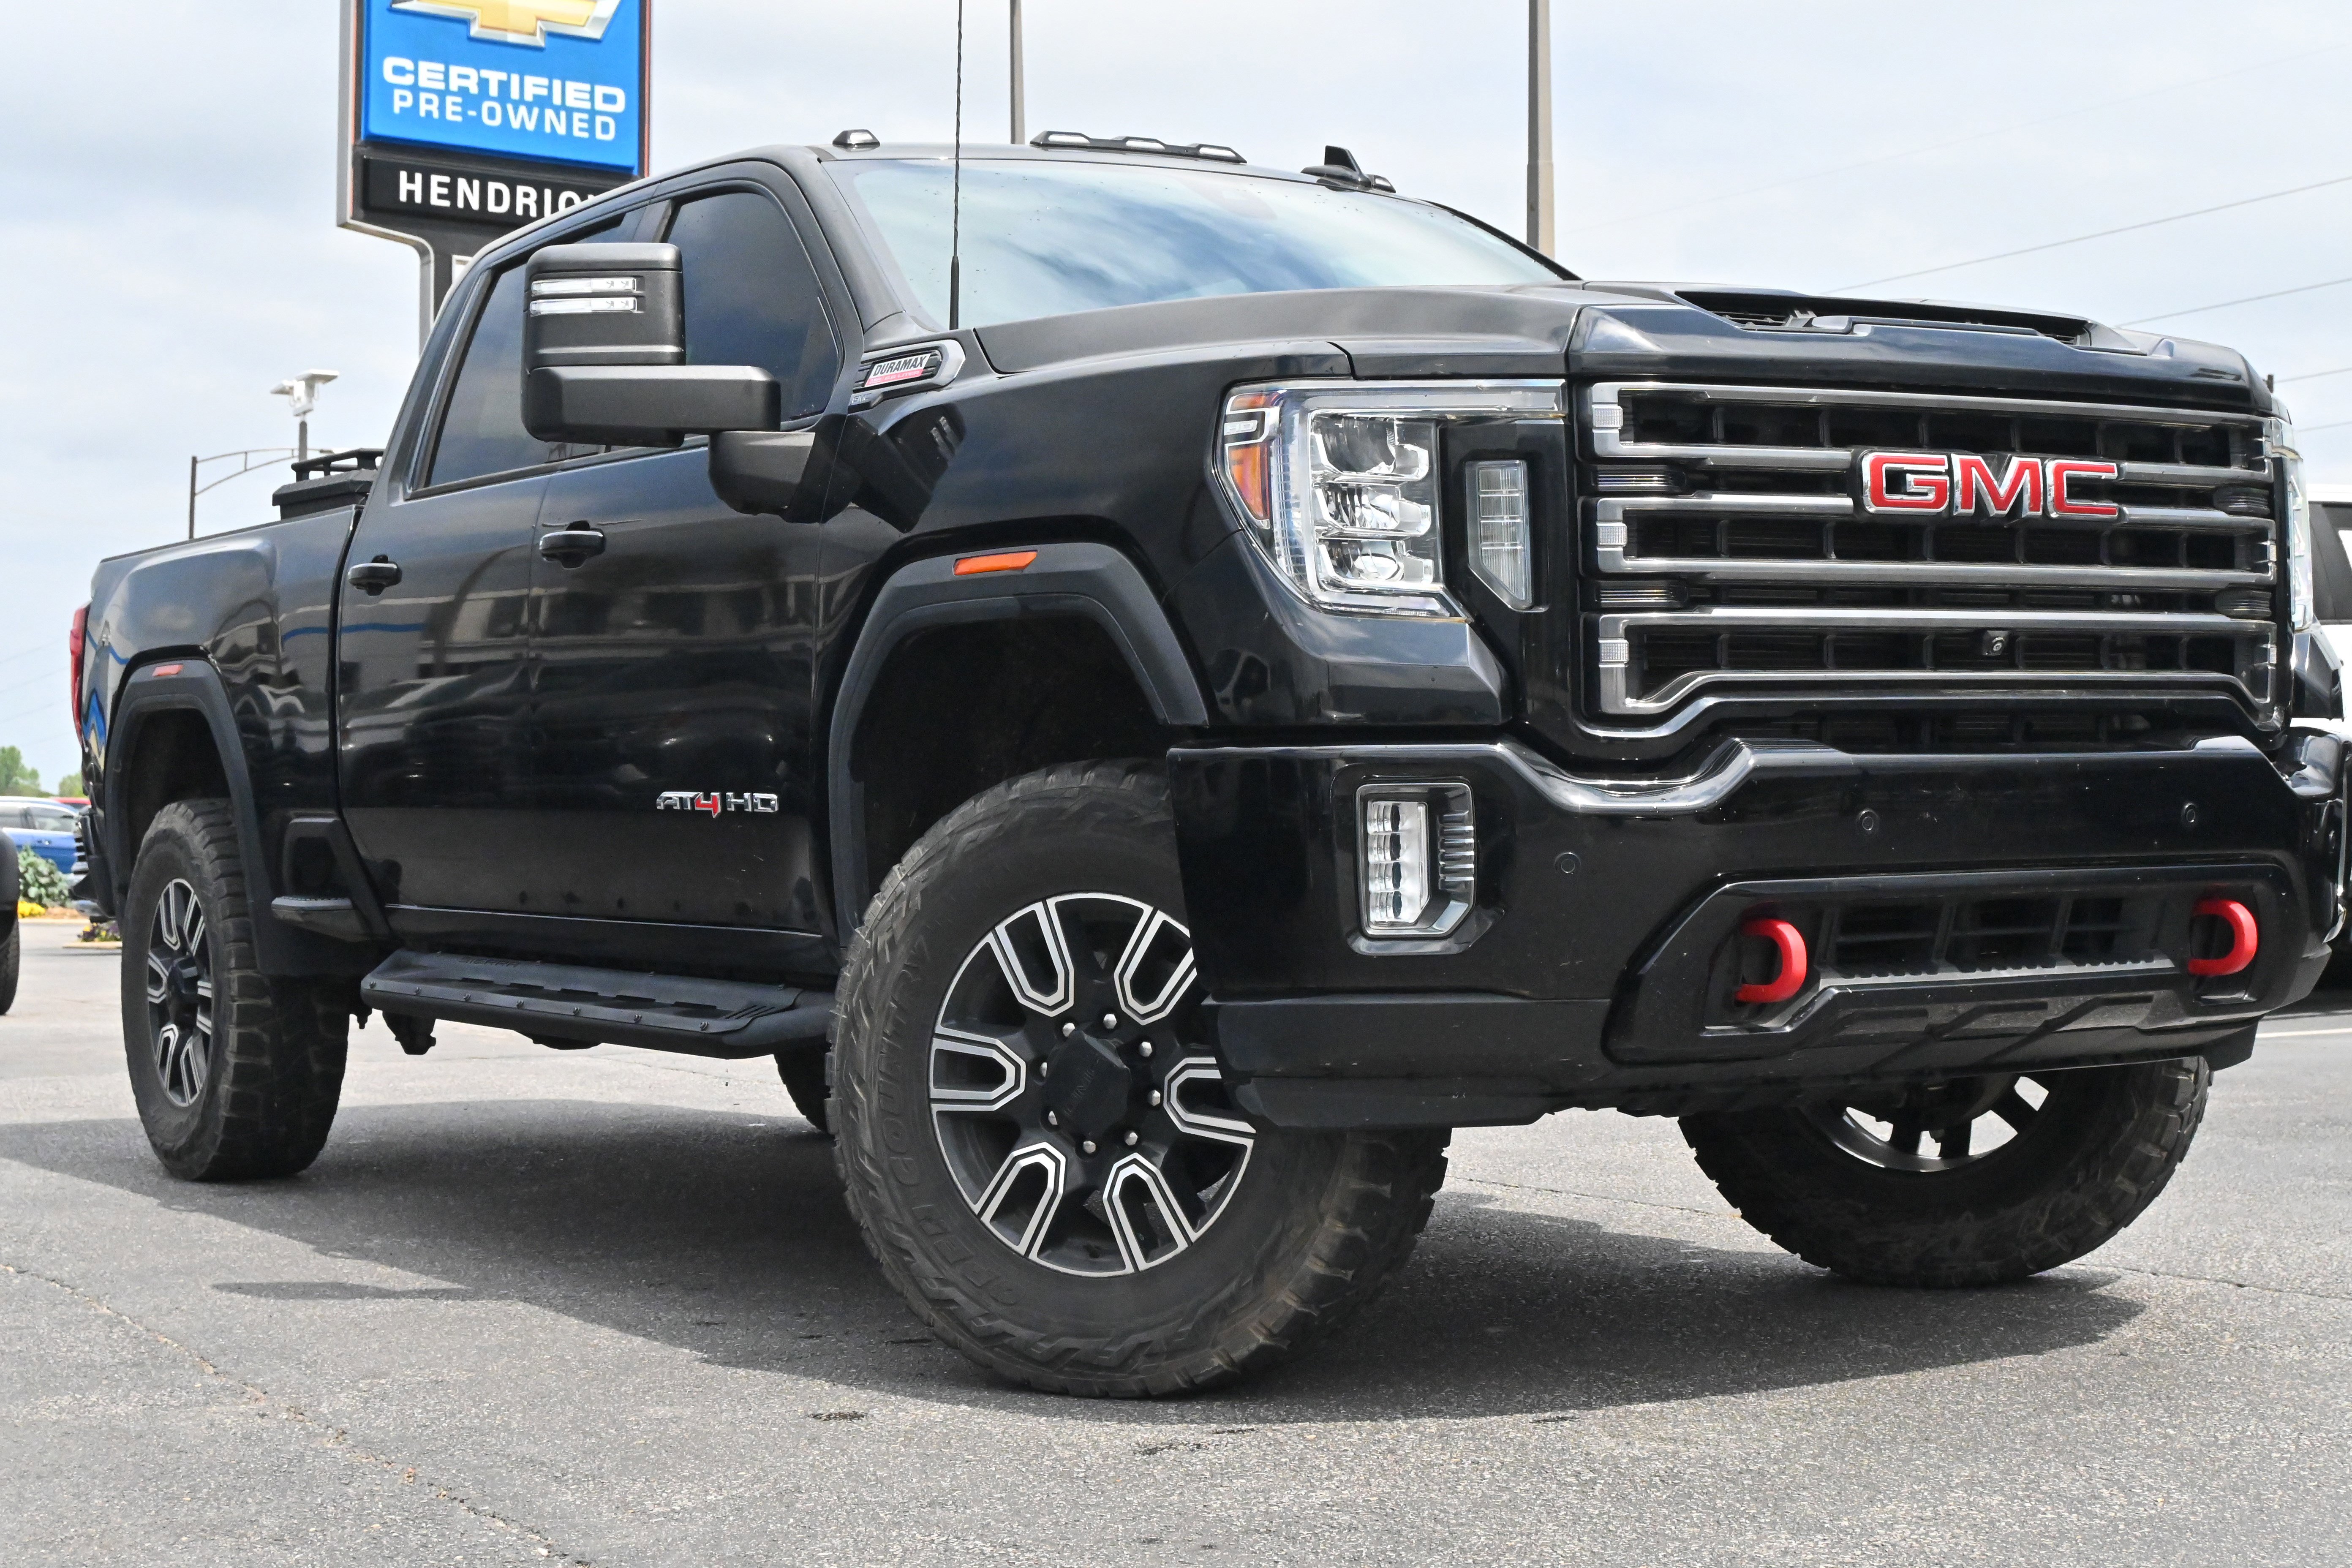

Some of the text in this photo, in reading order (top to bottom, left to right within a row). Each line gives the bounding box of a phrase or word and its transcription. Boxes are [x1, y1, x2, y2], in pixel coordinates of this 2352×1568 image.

[383, 56, 626, 113] CERTIFIED
[393, 90, 615, 141] PRE-OWNED
[873, 356, 927, 376] DURAMAX
[1225, 422, 1254, 433] HD
[1861, 451, 2119, 519] GMC
[726, 792, 779, 813] HD
